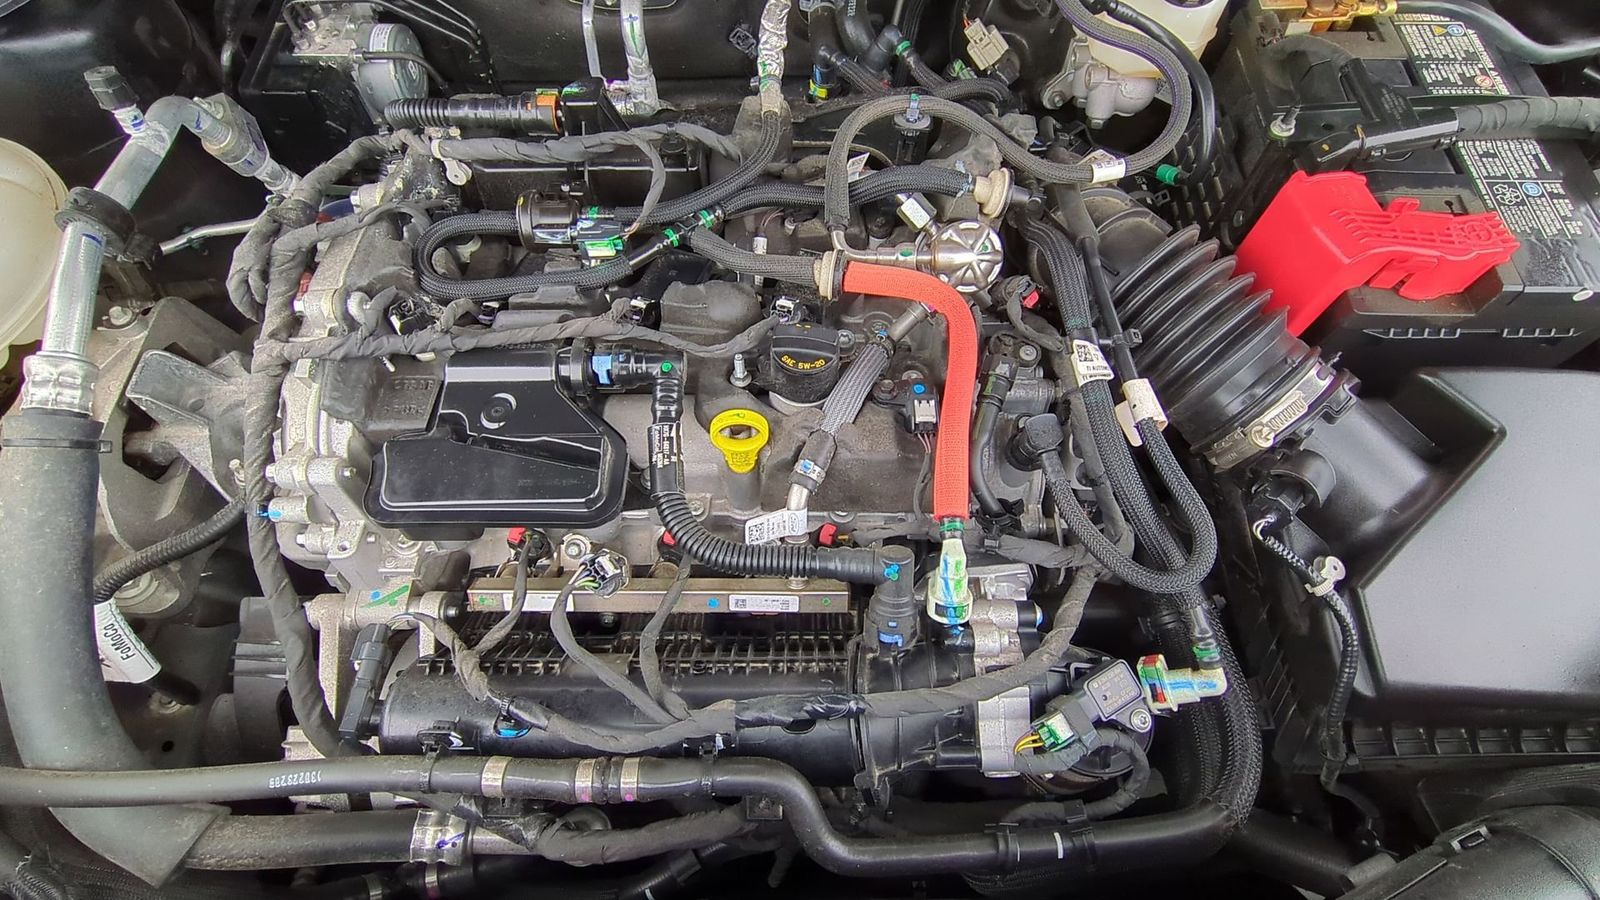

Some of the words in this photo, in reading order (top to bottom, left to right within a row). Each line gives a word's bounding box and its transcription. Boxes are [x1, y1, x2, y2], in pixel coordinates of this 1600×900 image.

[781, 355, 796, 367] SAE
[798, 358, 826, 370] 5W-20
[104, 623, 136, 661] FoMoCo
